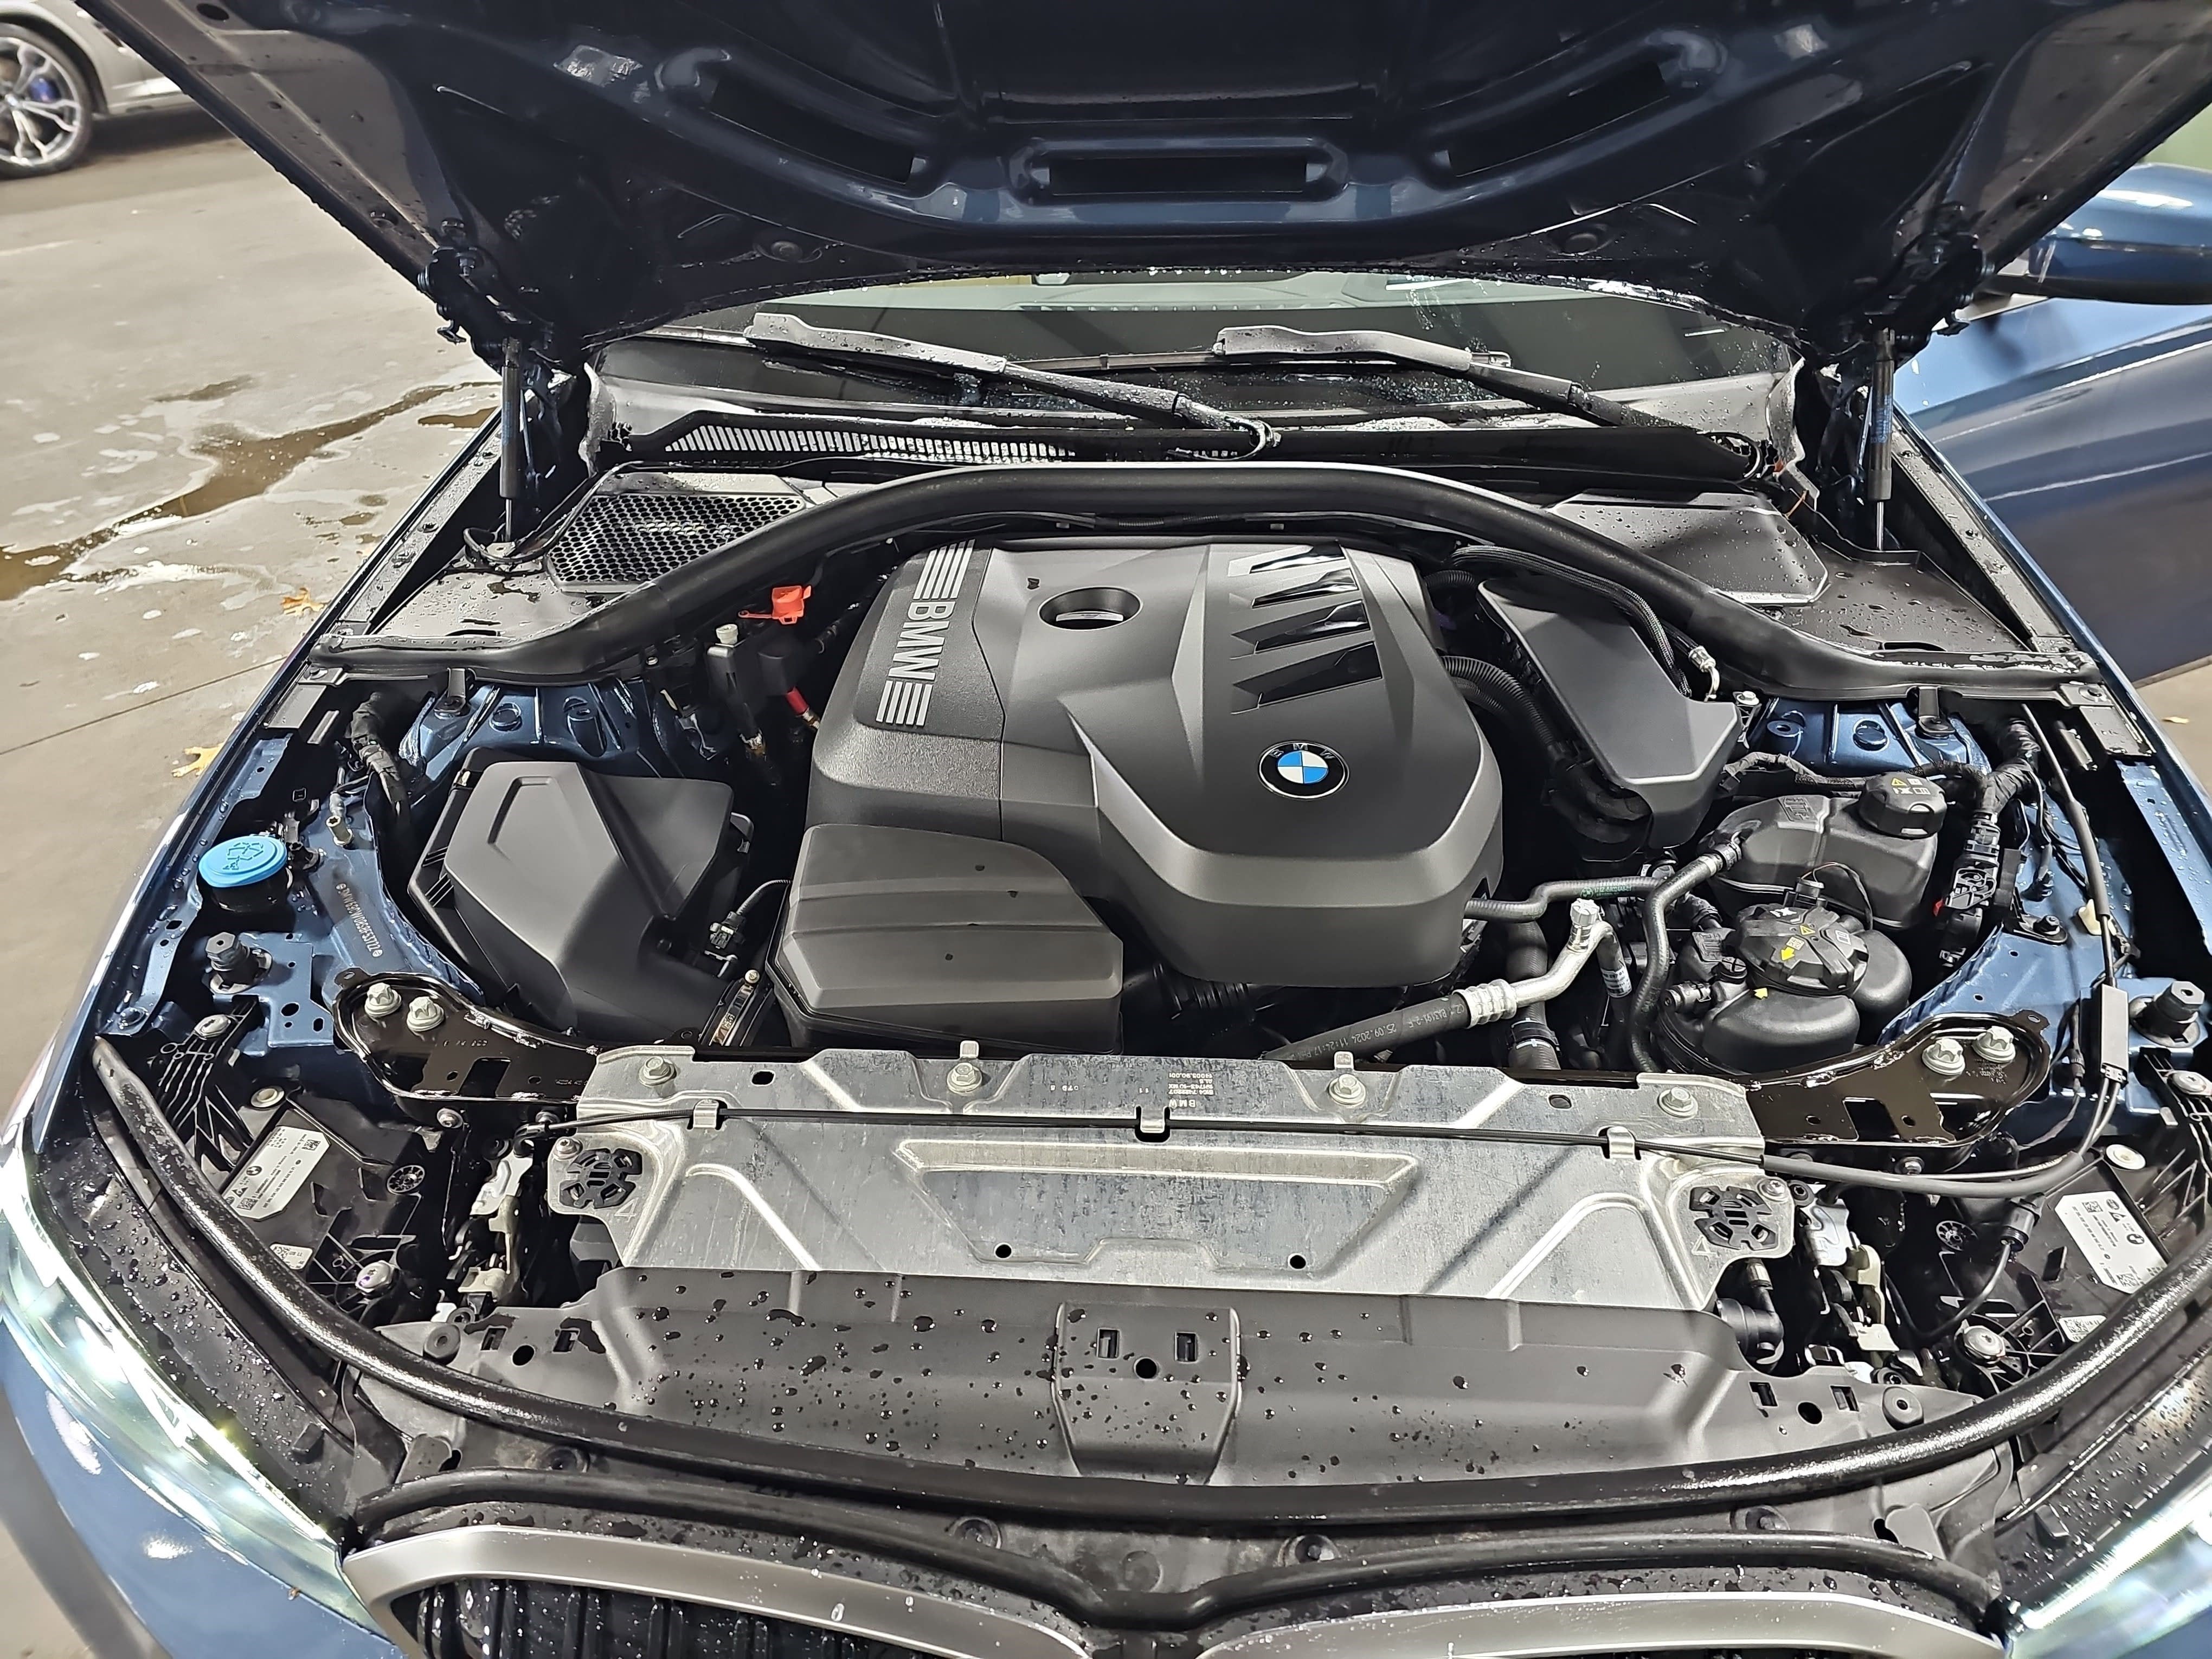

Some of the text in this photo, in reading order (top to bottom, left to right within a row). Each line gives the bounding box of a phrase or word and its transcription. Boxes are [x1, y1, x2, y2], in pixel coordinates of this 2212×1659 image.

[889, 601, 954, 681] BMW
[1270, 743, 1336, 760] BMW
[1351, 1023, 1397, 1044] 25.09.2024
[1314, 1038, 1349, 1056] 11:24:17
[1168, 1098, 1196, 1109] BMW
[614, 1197, 639, 1223] 4
